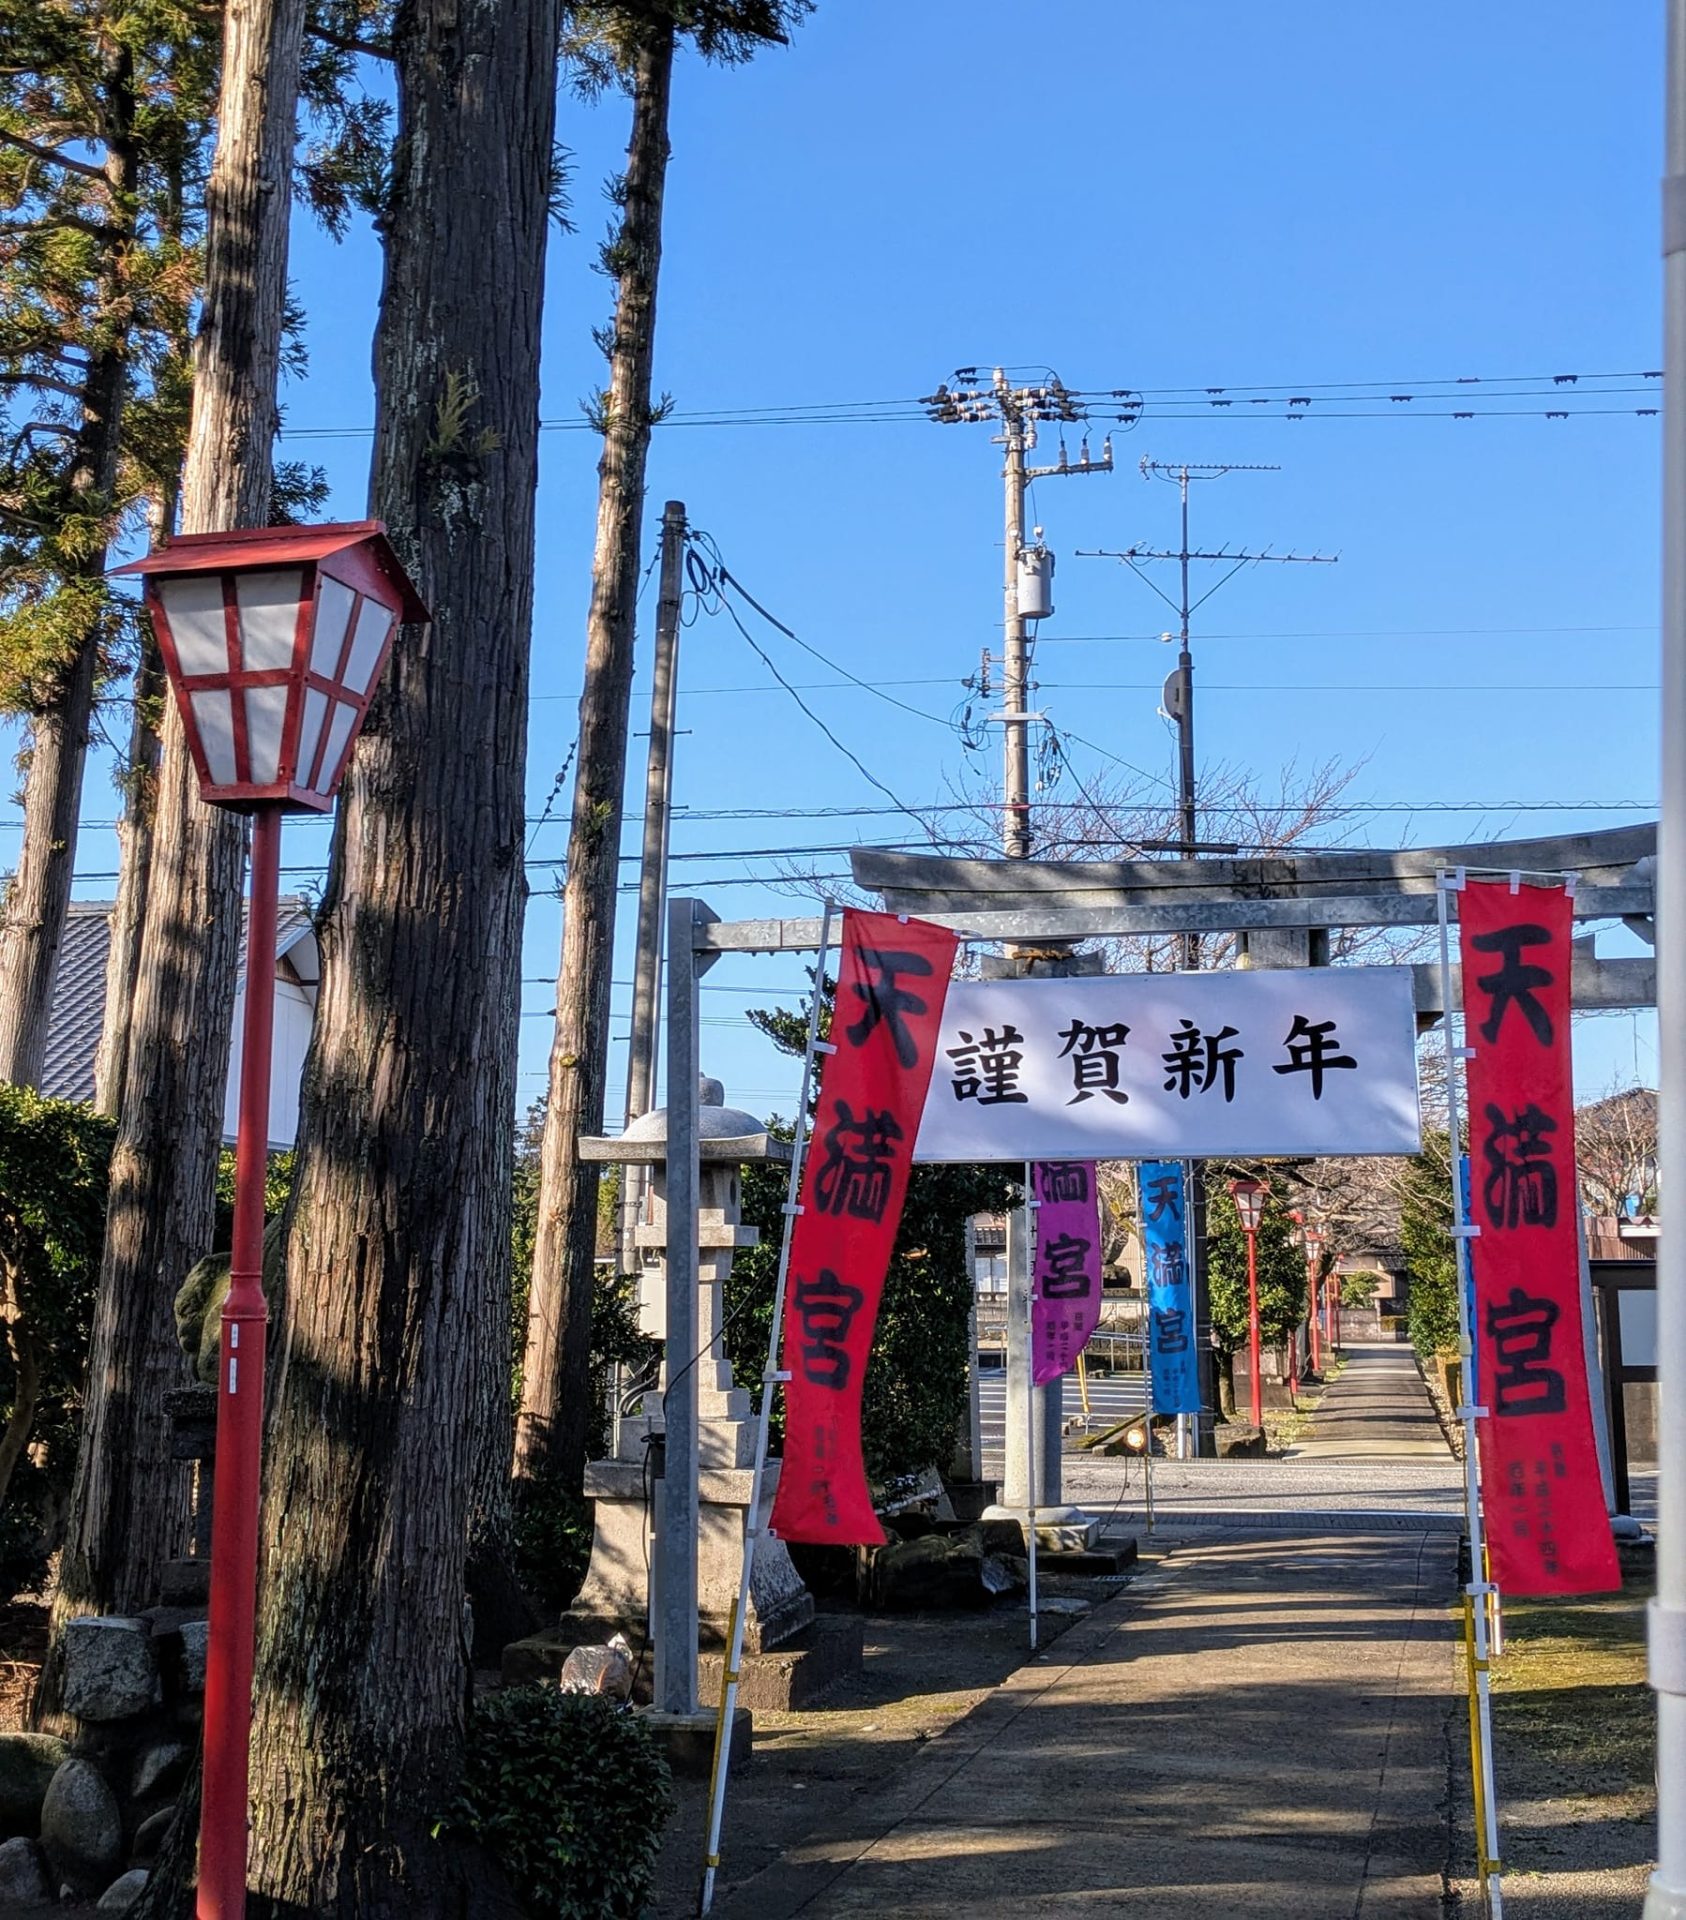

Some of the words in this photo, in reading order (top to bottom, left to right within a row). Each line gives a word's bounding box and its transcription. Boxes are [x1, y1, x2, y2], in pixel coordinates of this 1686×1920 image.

[794, 945, 933, 1392] 天満宮
[946, 1015, 1358, 1106] 謹賀新年
[1471, 923, 1568, 1418] 天満宮
[1147, 1175, 1188, 1355] 天満宮
